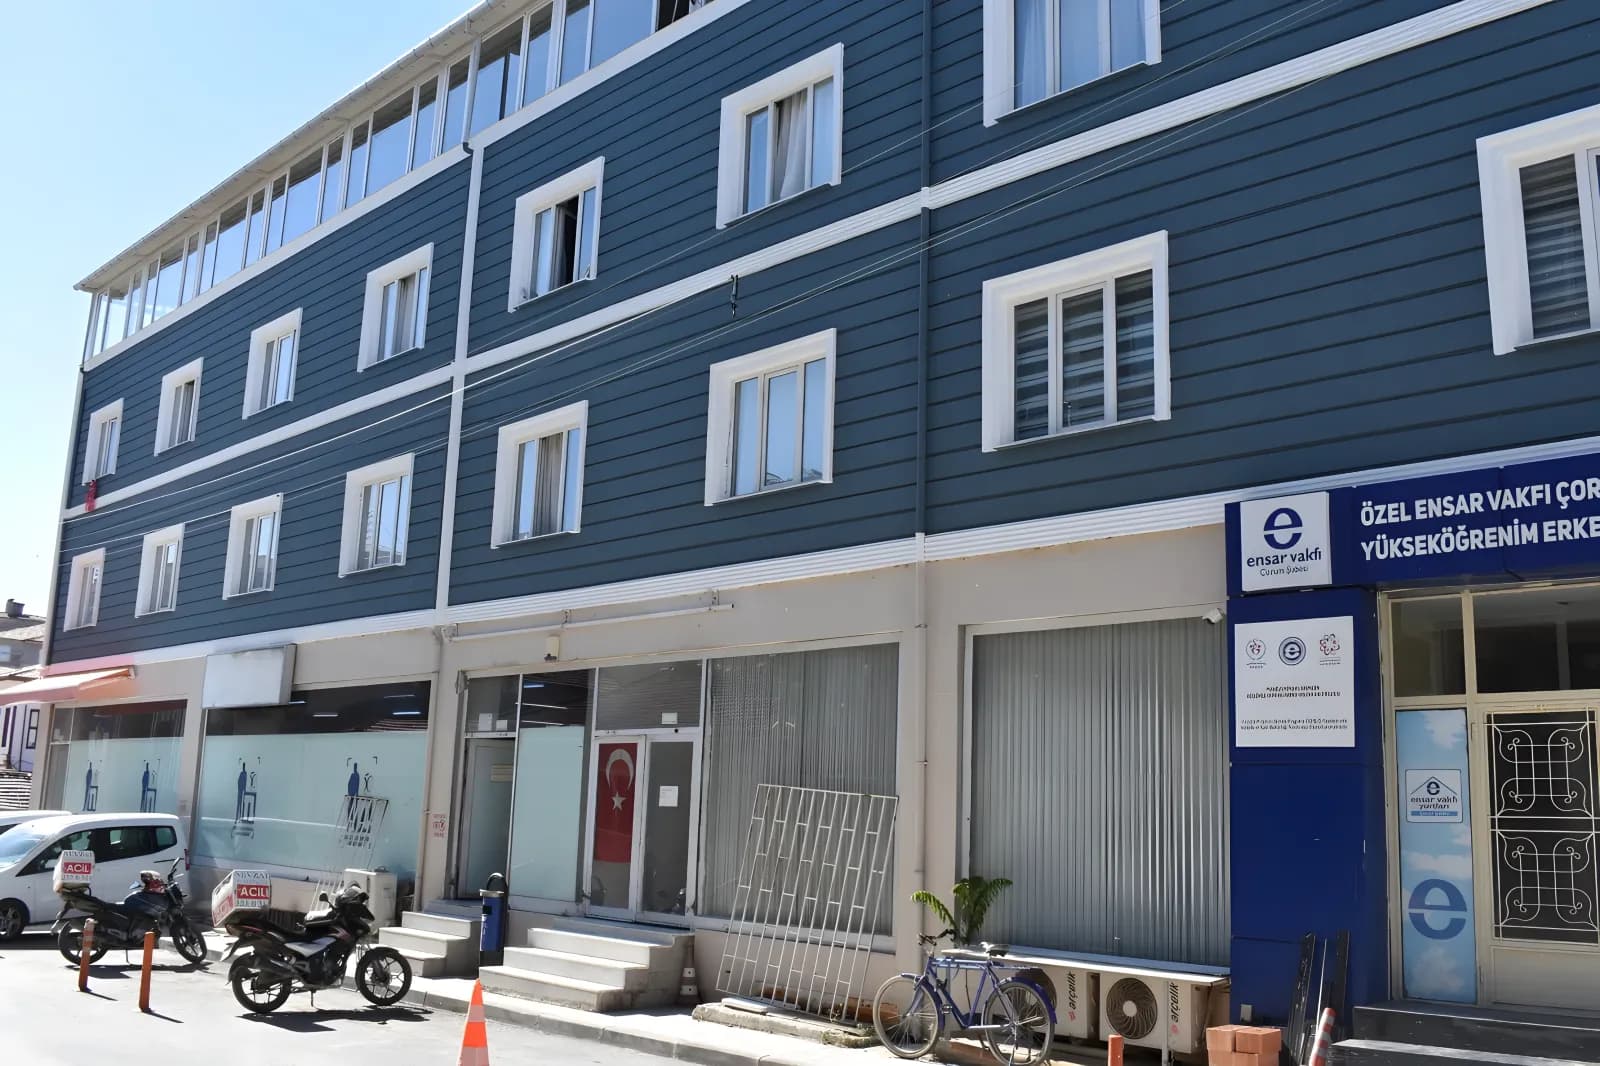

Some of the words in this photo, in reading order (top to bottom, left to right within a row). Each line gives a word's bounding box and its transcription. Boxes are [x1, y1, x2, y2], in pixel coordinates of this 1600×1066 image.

[1360, 501, 1412, 527] ÖZEL
[1414, 493, 1484, 520] ENSAR
[1486, 483, 1551, 511] VAKFI
[1555, 476, 1600, 510] ÇOR
[1246, 554, 1287, 567] ensar
[1361, 518, 1538, 561] YÜKSEKÖĞRENİM
